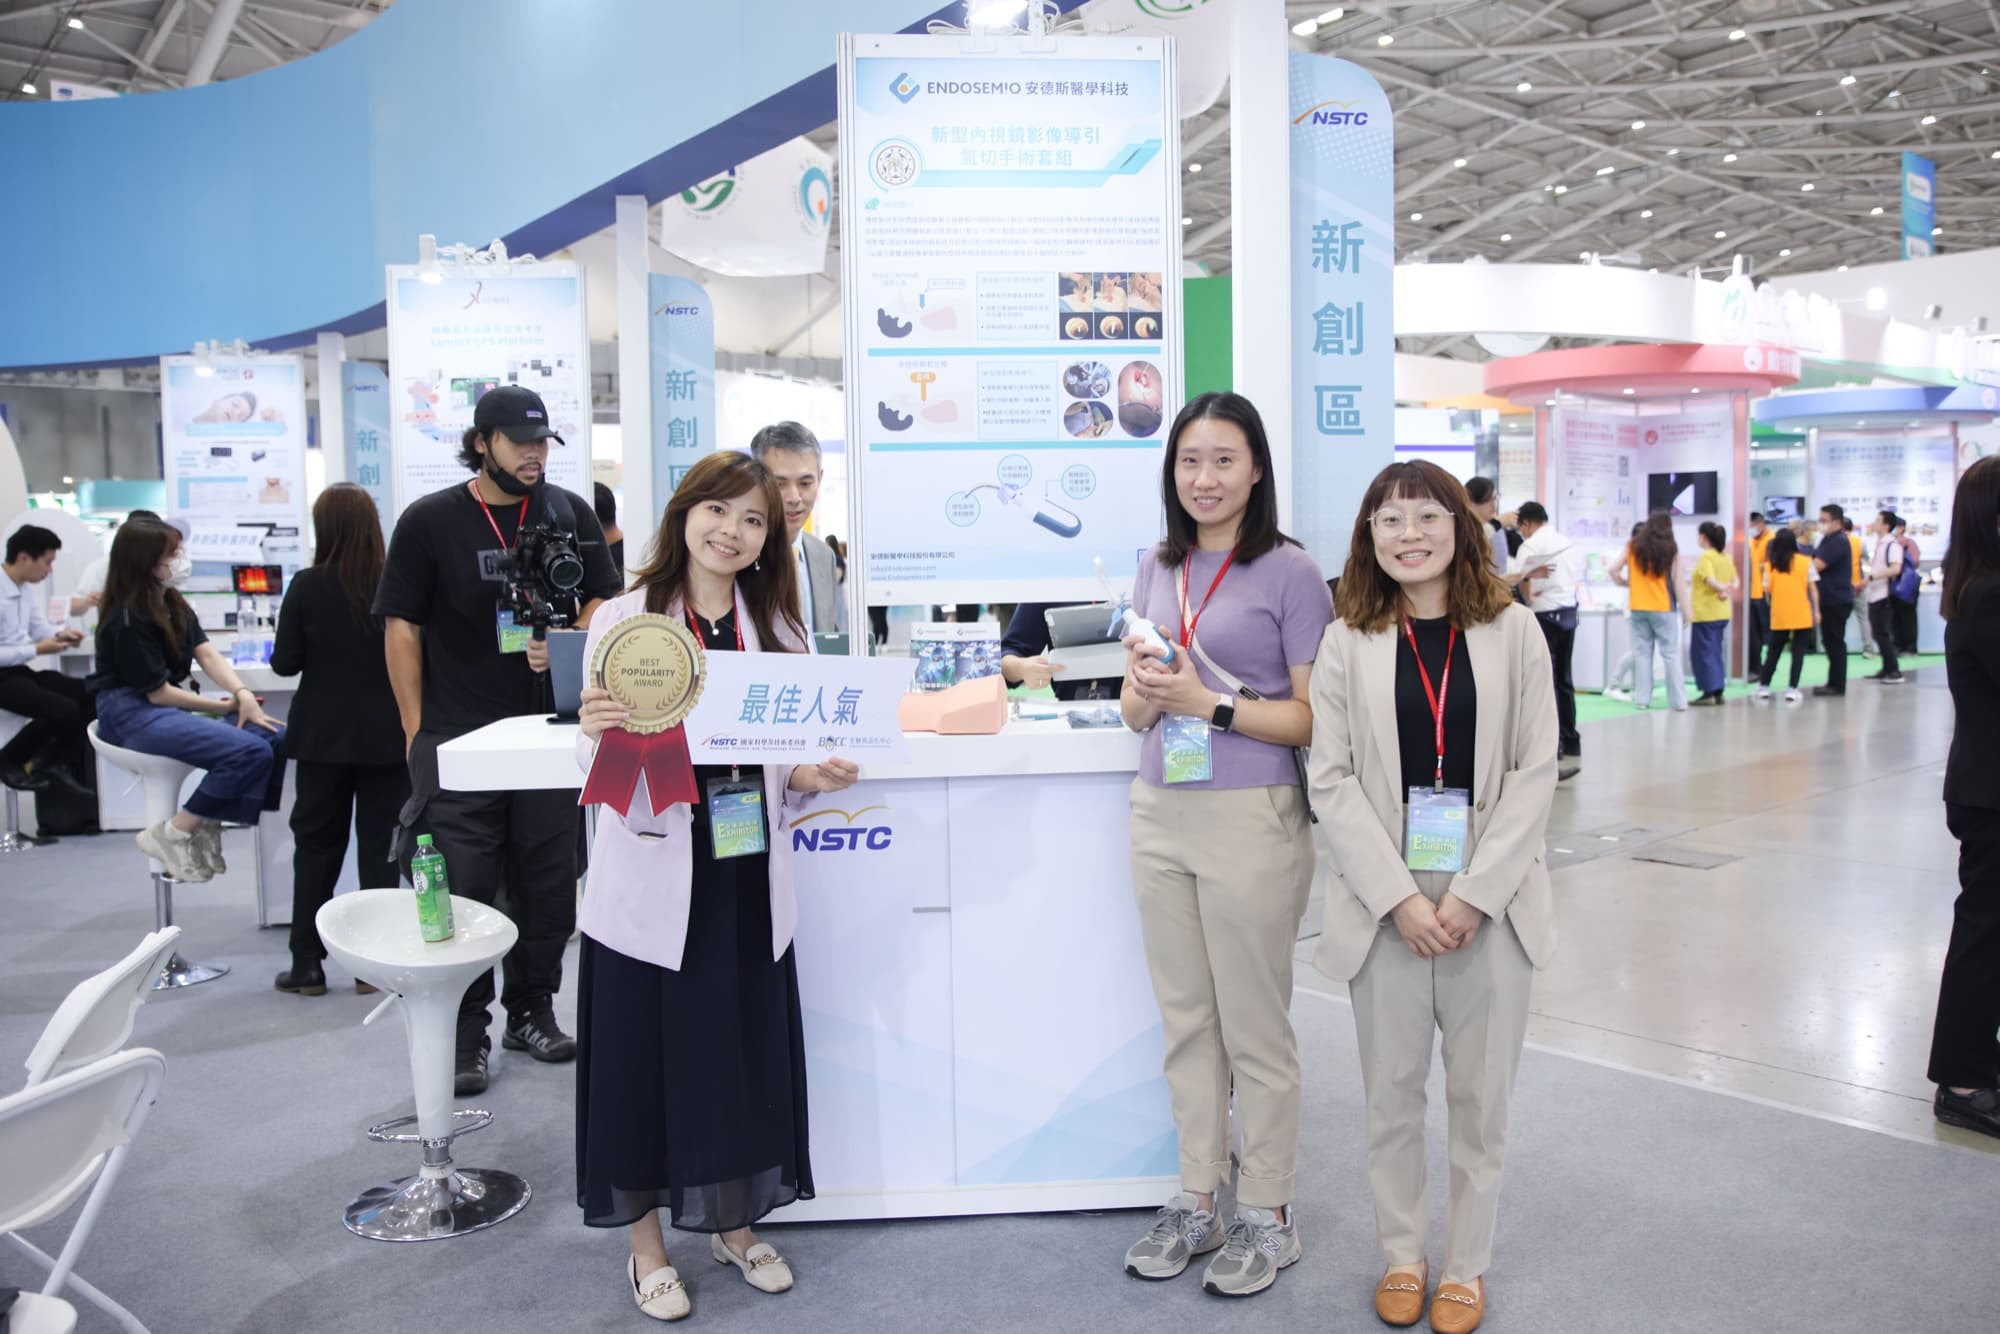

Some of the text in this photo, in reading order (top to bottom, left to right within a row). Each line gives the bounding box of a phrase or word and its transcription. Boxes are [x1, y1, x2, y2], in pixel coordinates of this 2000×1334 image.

[1025, 81, 1129, 96] 安德斯醫學科技
[1313, 111, 1368, 126] NSTC
[665, 306, 699, 316] NSTC
[1312, 219, 1365, 435] 新創區
[640, 658, 660, 666] BEST
[621, 668, 675, 677] POPULARITY
[634, 679, 663, 687] AWARD
[738, 684, 863, 727] 最佳人氣
[710, 738, 738, 746] NSTC
[793, 827, 893, 852] NSTC
